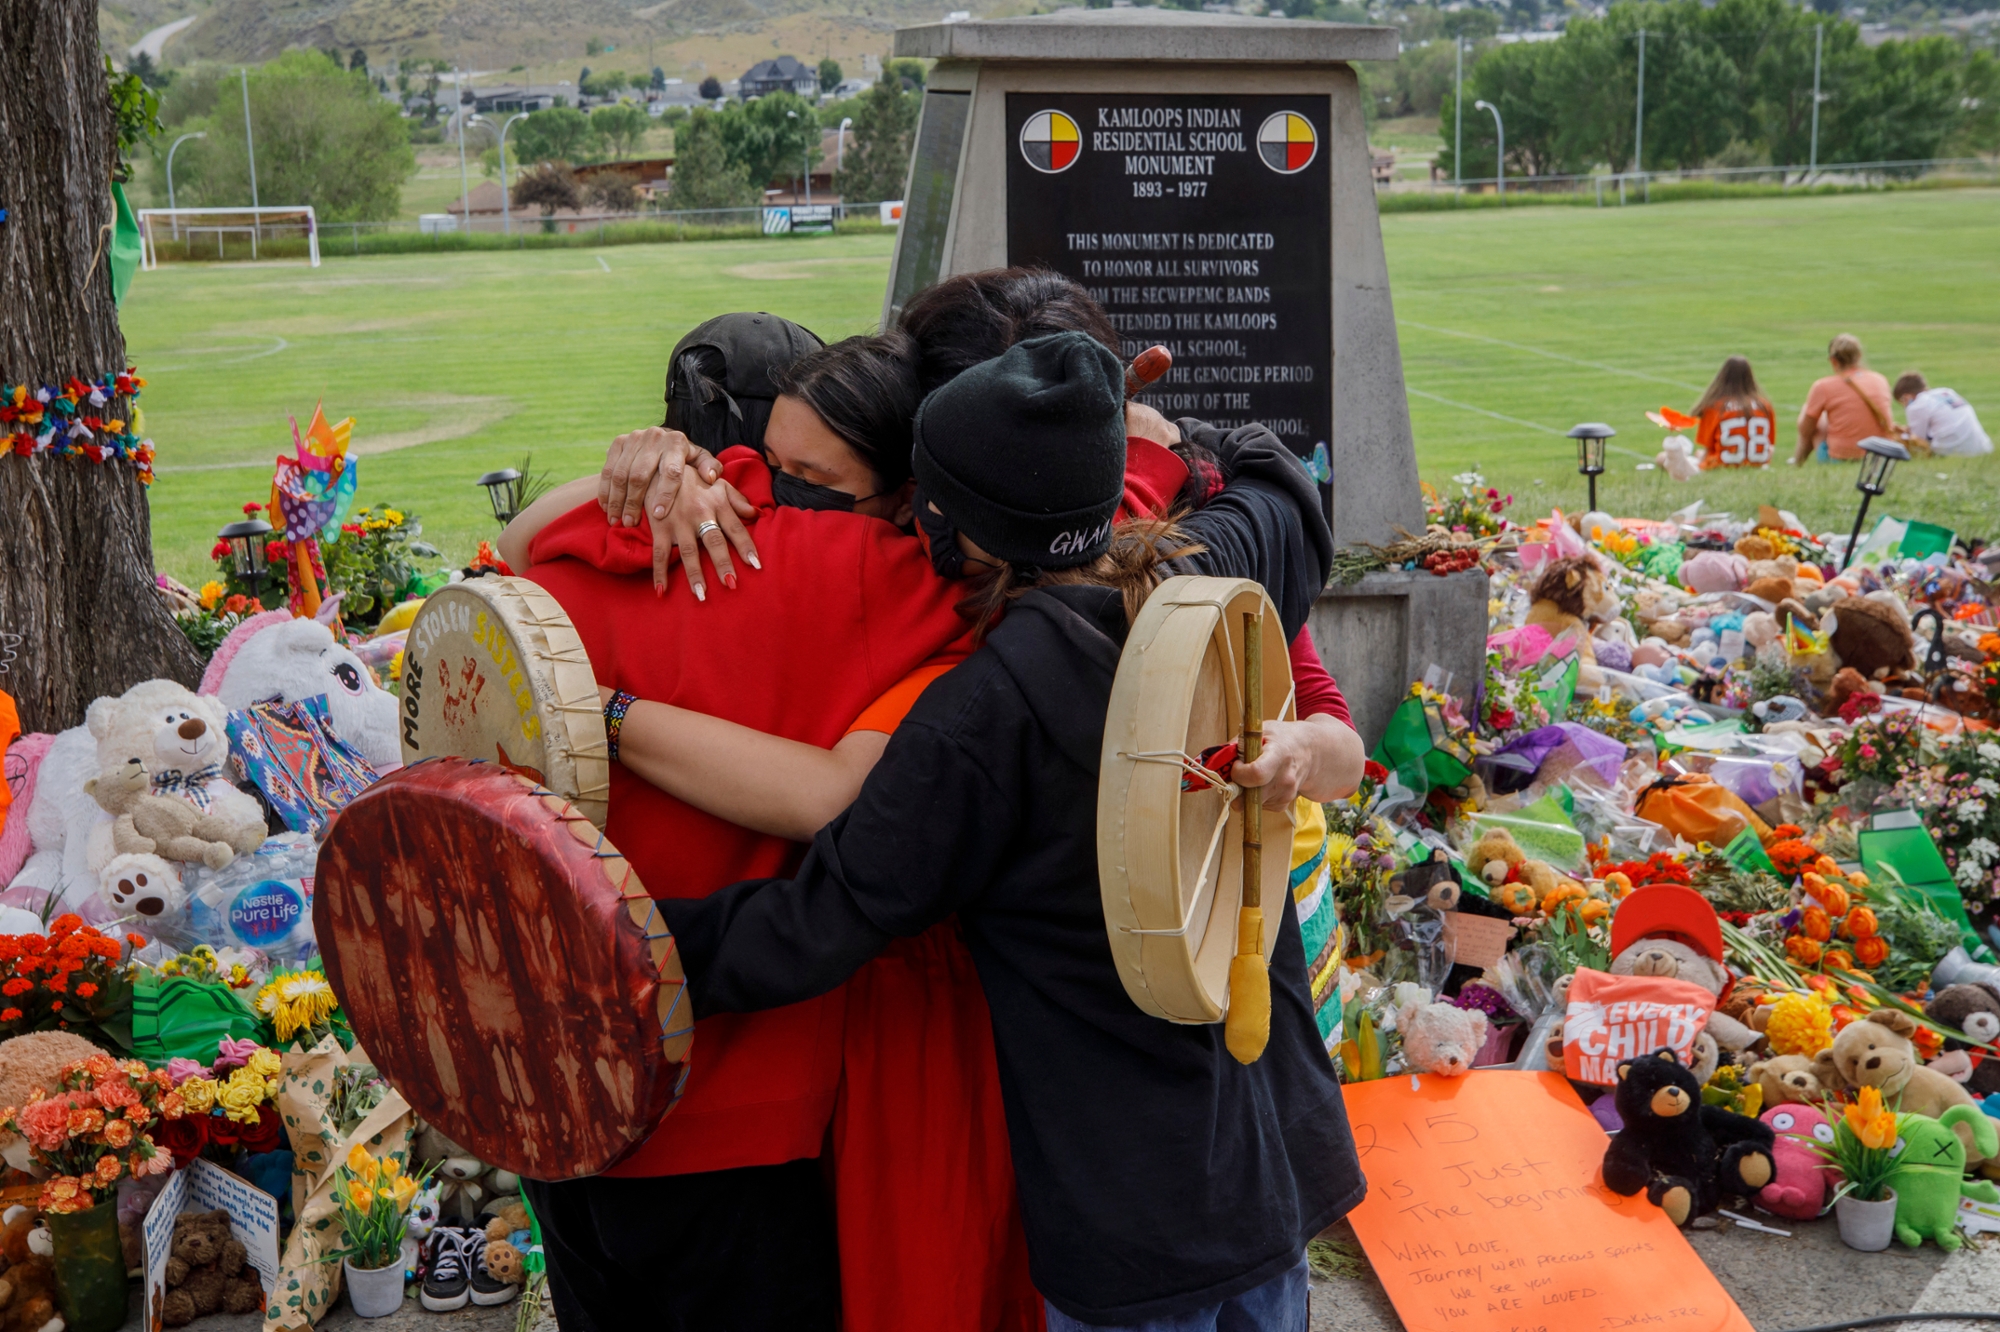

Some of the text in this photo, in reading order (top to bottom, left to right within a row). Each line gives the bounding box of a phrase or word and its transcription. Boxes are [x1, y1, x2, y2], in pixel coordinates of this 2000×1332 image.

[1098, 108, 1241, 128] KAMLOOPS INDIAN
[1093, 132, 1246, 152] RESIDENTIAL SCHOOL
[1125, 156, 1215, 175] MONUMENT
[1133, 182, 1162, 197] 1893
[1178, 182, 1208, 197] 1977
[1067, 233, 1274, 250] THIS MONUMENT IS DEDICATED
[1083, 260, 1259, 277] TO HONOR ALL SURVIVORS
[1112, 287, 1139, 304] THE
[1142, 287, 1224, 304] SECWEPEMC
[1227, 286, 1271, 303] BANDS
[1107, 313, 1277, 330] TTENDED THE KAMLOOPS
[1187, 340, 1247, 359] SCHOOL;
[1166, 366, 1314, 383] THE GENOCIDE PERIOD
[1142, 393, 1251, 410] HISTORY OF THE
[1720, 416, 1770, 464] 58
[404, 600, 541, 750] MORE STOLEN SISTERS
[242, 894, 284, 909] Nestlé
[232, 903, 299, 922] Pure Life
[1609, 1001, 1706, 1025] EVERY
[1579, 1020, 1695, 1060] CHILD
[1355, 1113, 1480, 1158] 215
[1442, 1158, 1551, 1187] Just
[1398, 1181, 1622, 1222] The beginning
[1381, 1240, 1446, 1262] With
[1409, 1264, 1482, 1285] Journey
[1537, 1250, 1595, 1268] precious
[1450, 1286, 1474, 1300] We
[1490, 1282, 1513, 1294] see
[1486, 1298, 1523, 1314] ARE
